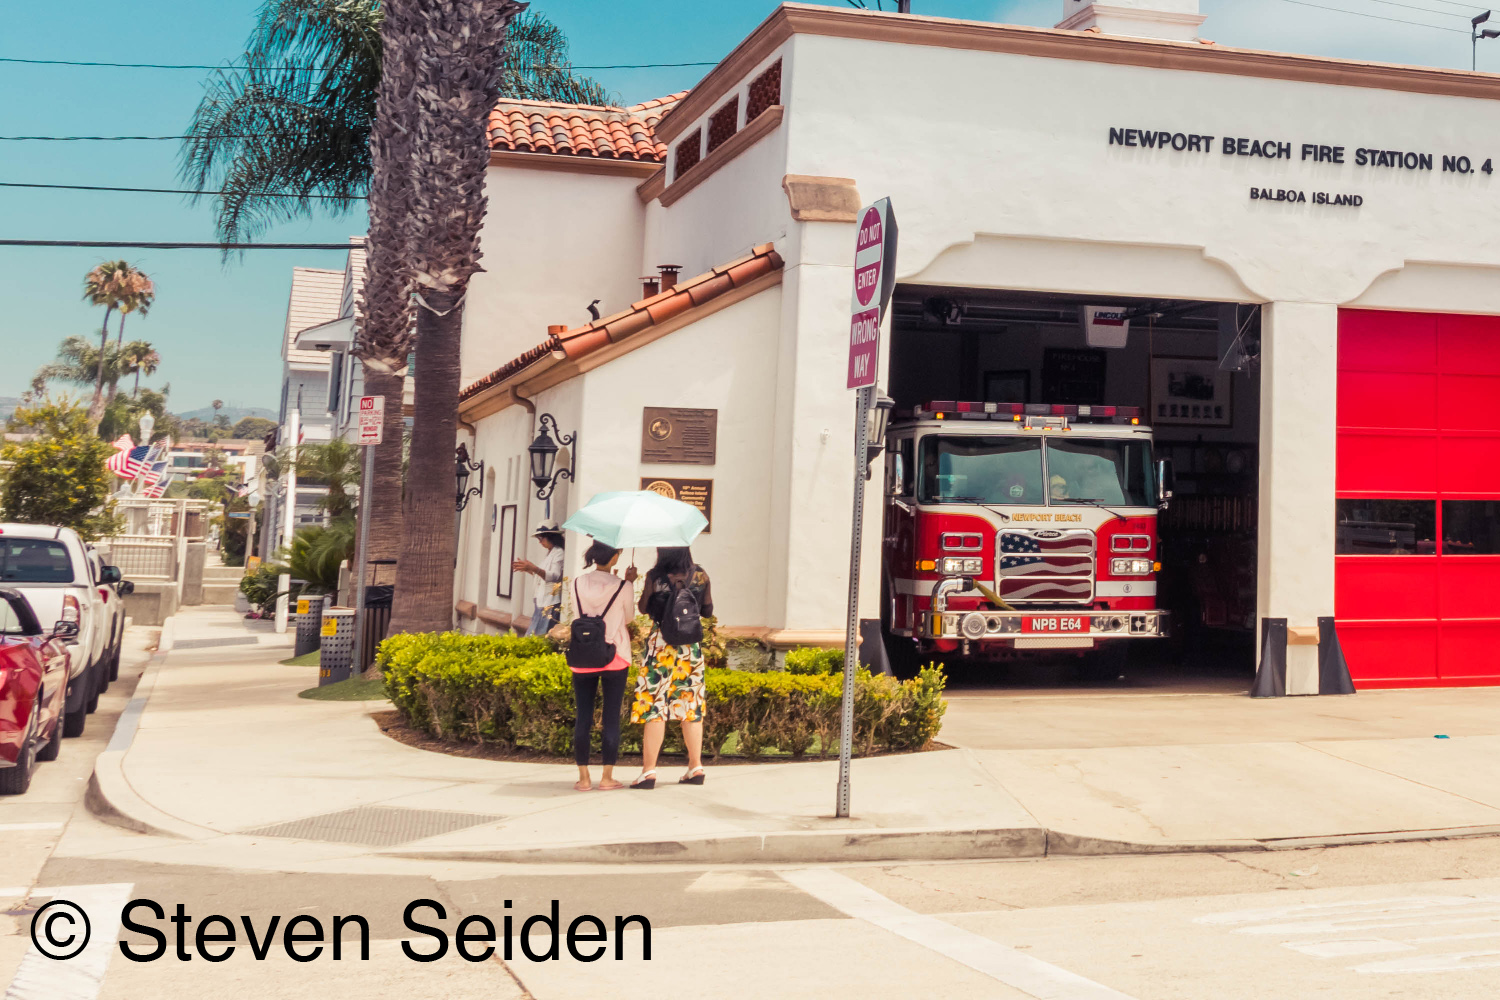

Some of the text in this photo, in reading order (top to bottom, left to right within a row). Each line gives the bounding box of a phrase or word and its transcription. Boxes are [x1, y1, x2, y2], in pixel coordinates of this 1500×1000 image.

[1108, 127, 1494, 175] NEWPORT BEACH FIRE STATION NO. 4
[1250, 187, 1364, 208] BALBOA ISLAND
[860, 222, 880, 246] DO NOT
[858, 269, 877, 290] ENTER
[852, 318, 876, 346] WRONG
[854, 352, 870, 379] WAY
[362, 400, 373, 409] NO
[1012, 513, 1082, 522] NEWPORT BEACH
[1032, 618, 1082, 630] NPB E64
